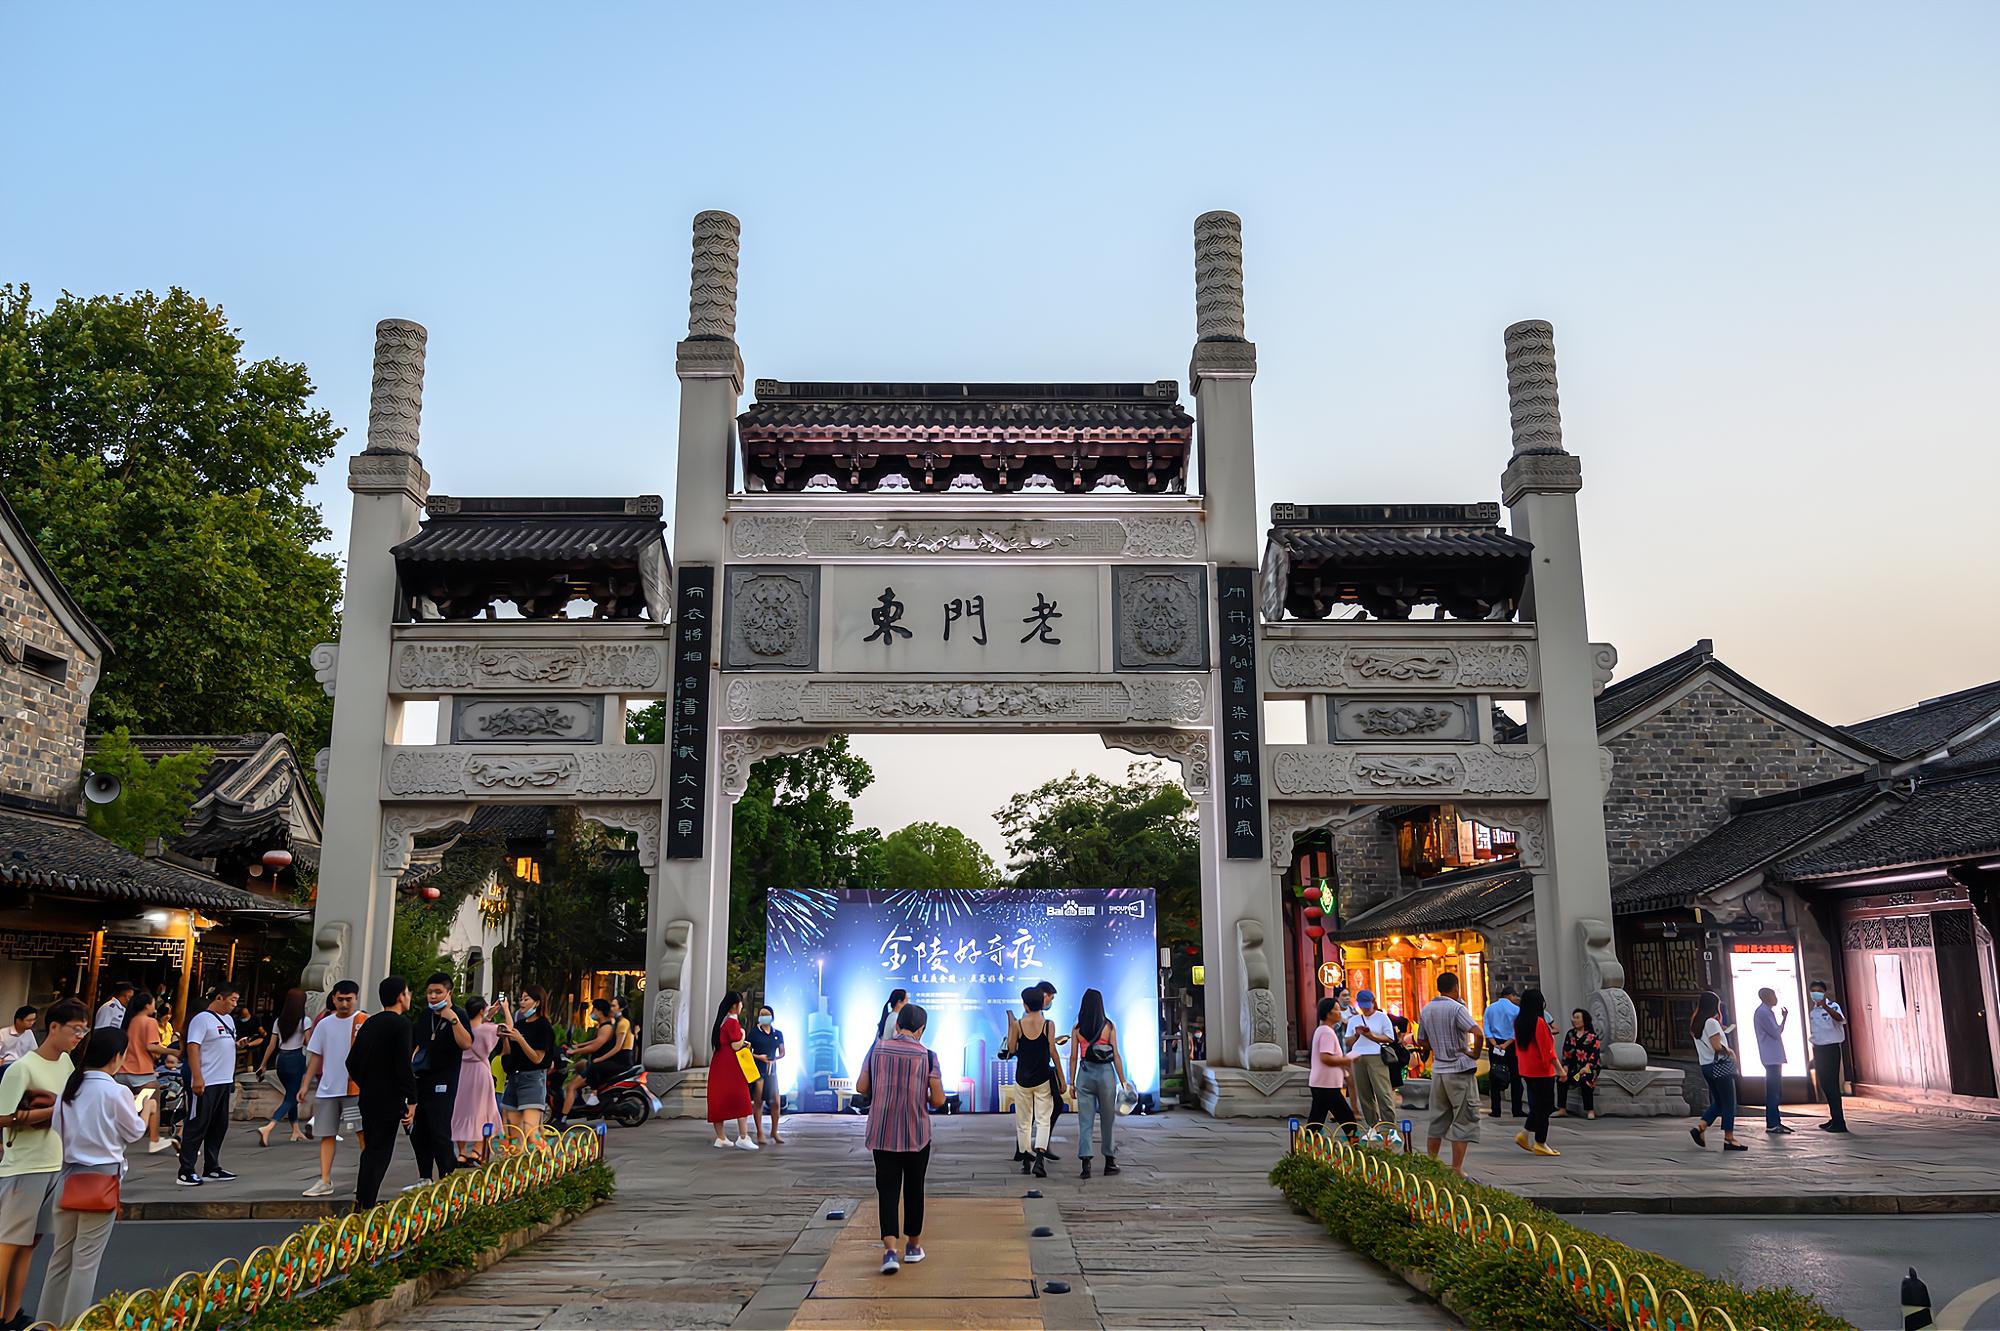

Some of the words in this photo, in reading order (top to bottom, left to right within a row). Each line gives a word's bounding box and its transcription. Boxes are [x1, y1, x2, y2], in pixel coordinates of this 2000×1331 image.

[879, 923, 1044, 974] 金陵好奇夜
